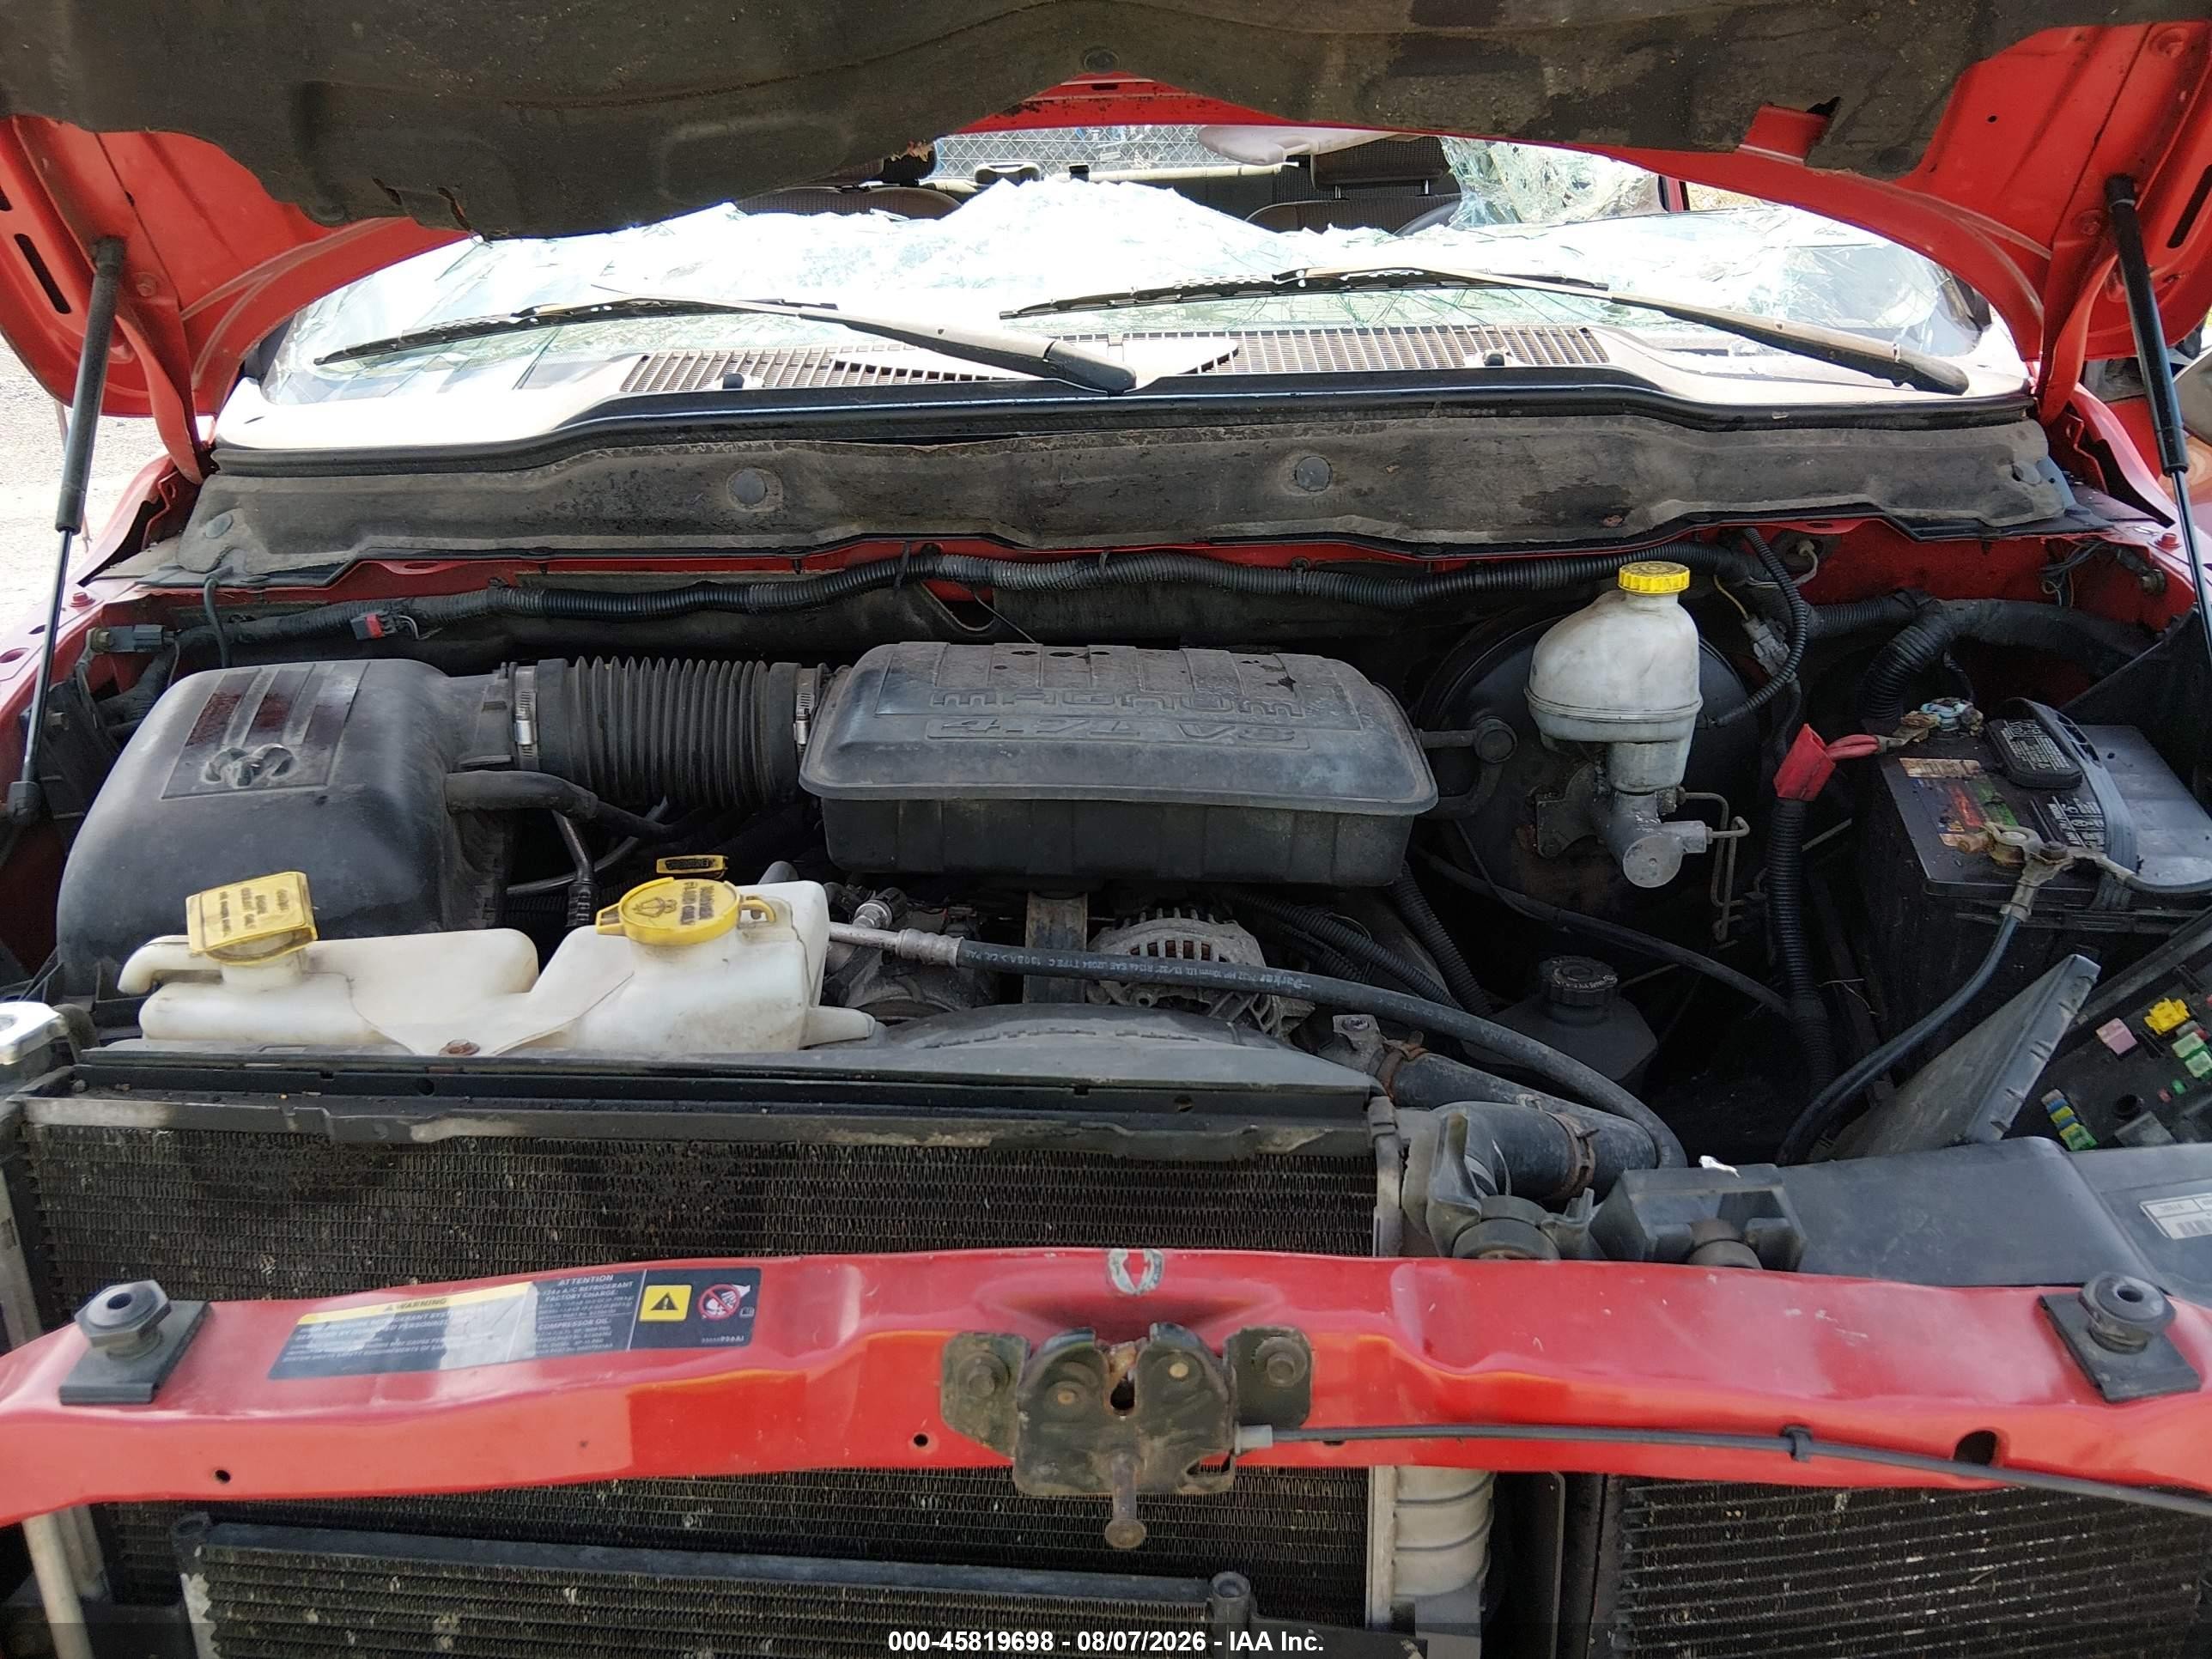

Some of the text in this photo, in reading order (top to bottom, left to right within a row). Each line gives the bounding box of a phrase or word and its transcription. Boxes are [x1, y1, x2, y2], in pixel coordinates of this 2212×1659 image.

[557, 1274, 614, 1285] ATTENTION
[579, 1280, 634, 1291] REFRIGERANT
[582, 1290, 618, 1298] CHARGE:
[396, 1297, 447, 1310] WARNING
[538, 1319, 593, 1330] COMPRESSOR
